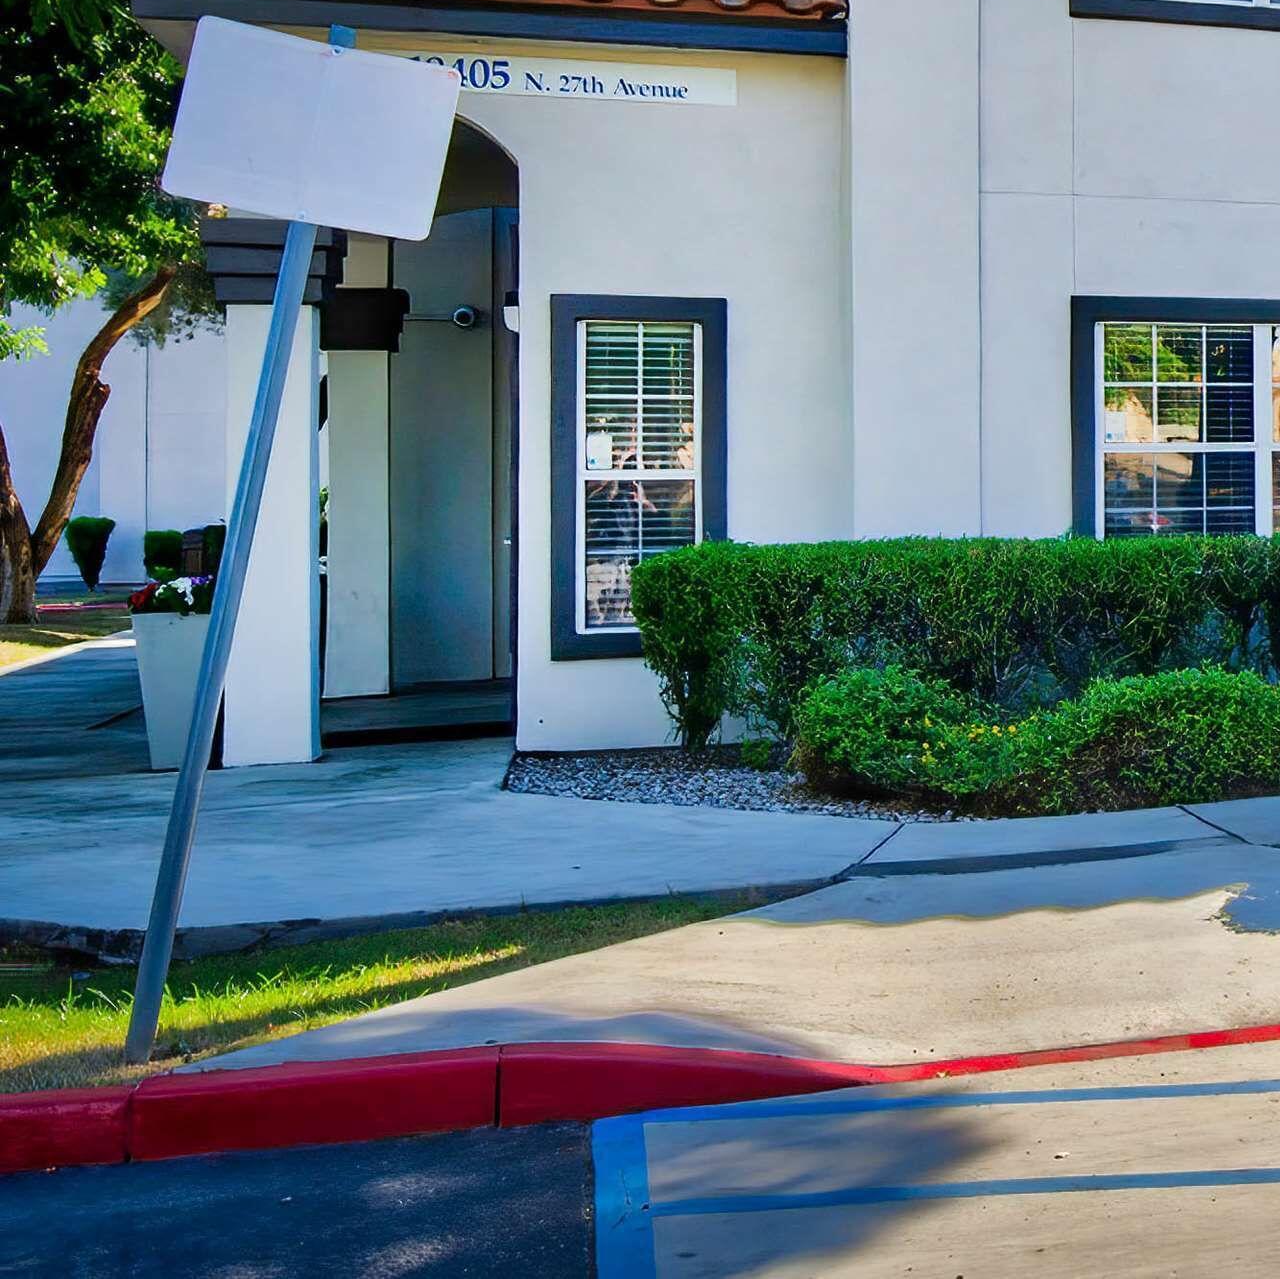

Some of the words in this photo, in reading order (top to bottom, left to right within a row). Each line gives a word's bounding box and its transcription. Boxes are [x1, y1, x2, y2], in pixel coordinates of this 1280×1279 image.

[410, 56, 510, 89] 405
[525, 72, 550, 91] N.
[559, 75, 604, 93] 27th
[614, 78, 688, 99] Avenue
